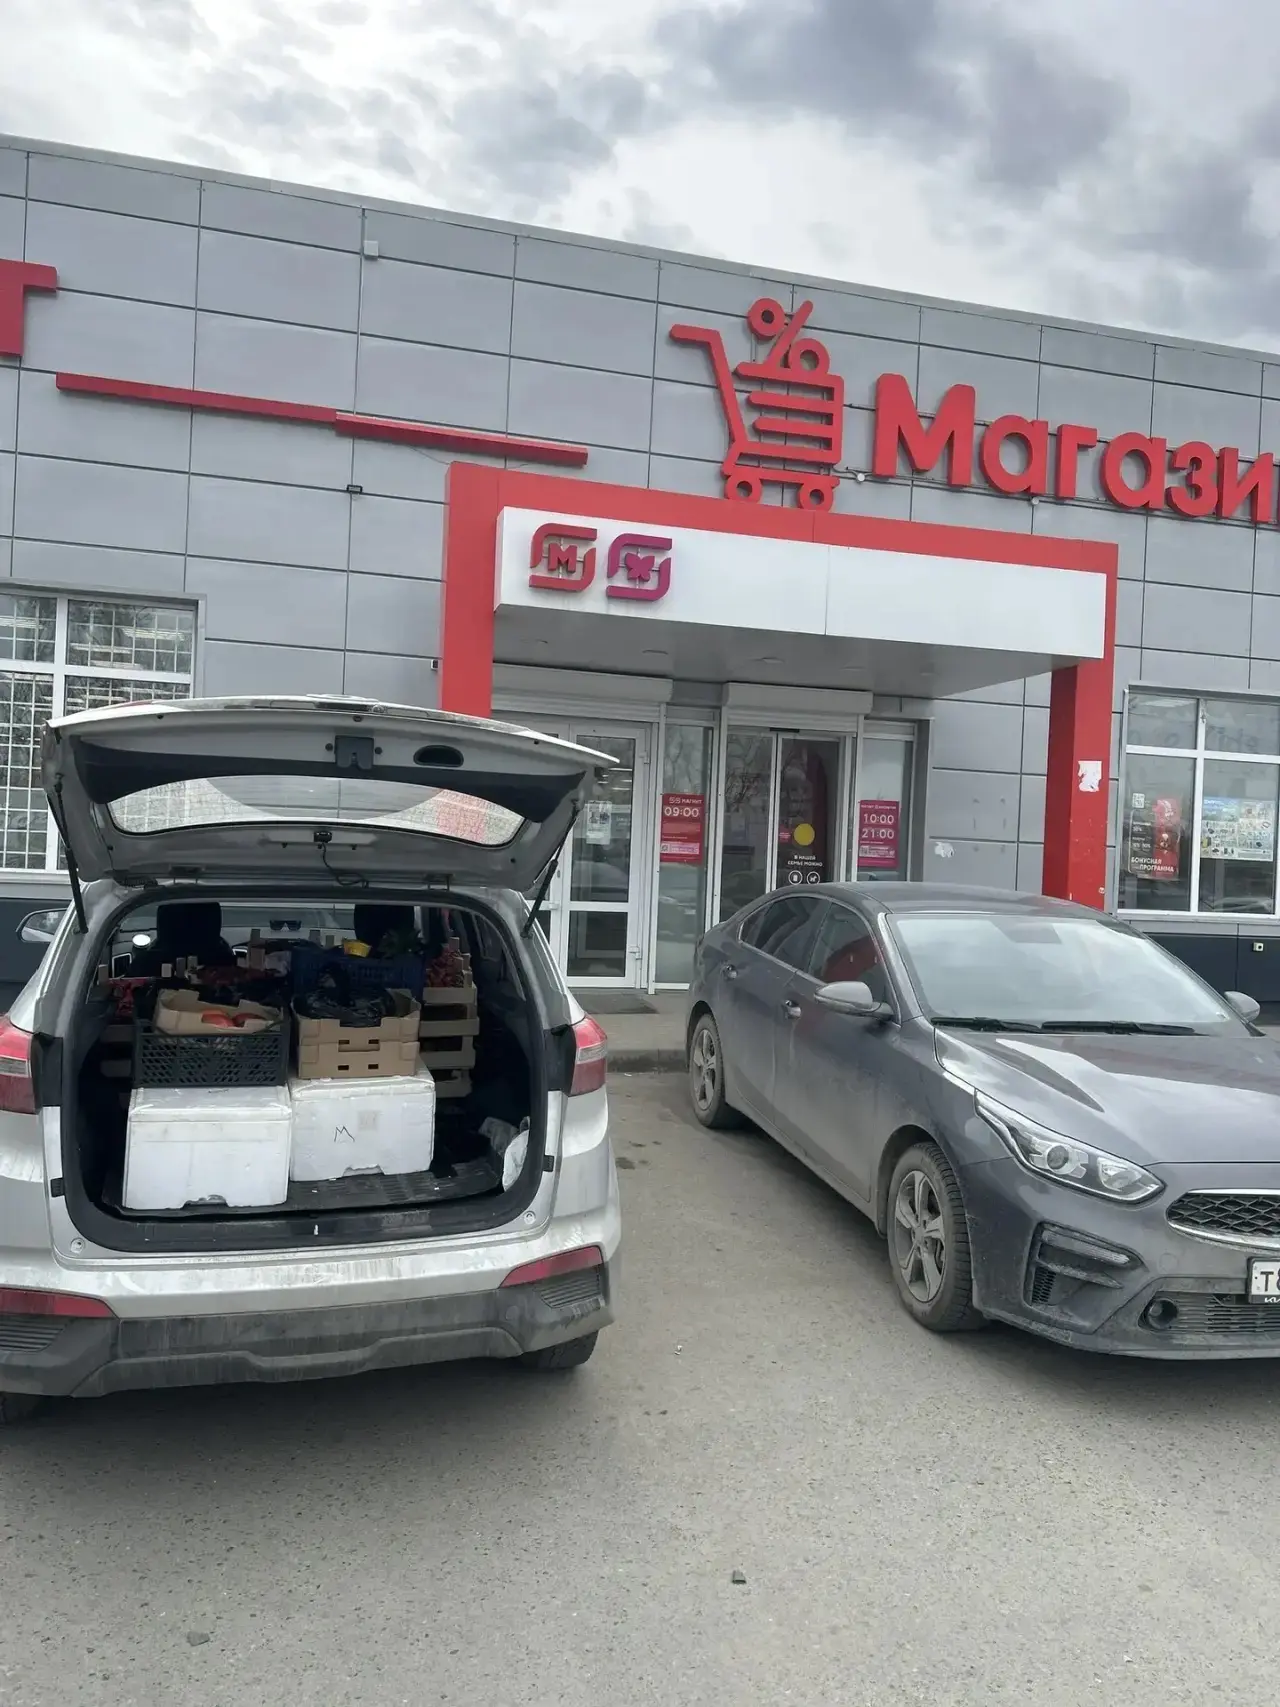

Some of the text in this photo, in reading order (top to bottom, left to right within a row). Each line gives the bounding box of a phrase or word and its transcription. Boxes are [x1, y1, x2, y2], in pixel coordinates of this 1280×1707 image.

[874, 373, 1280, 526] Магази
[664, 806, 699, 817] 09:00
[863, 813, 894, 824] 10:00
[861, 828, 895, 839] 21:00
[1131, 856, 1162, 864] БОНУСНАЯ
[1139, 864, 1175, 872] ПРОГРАММА
